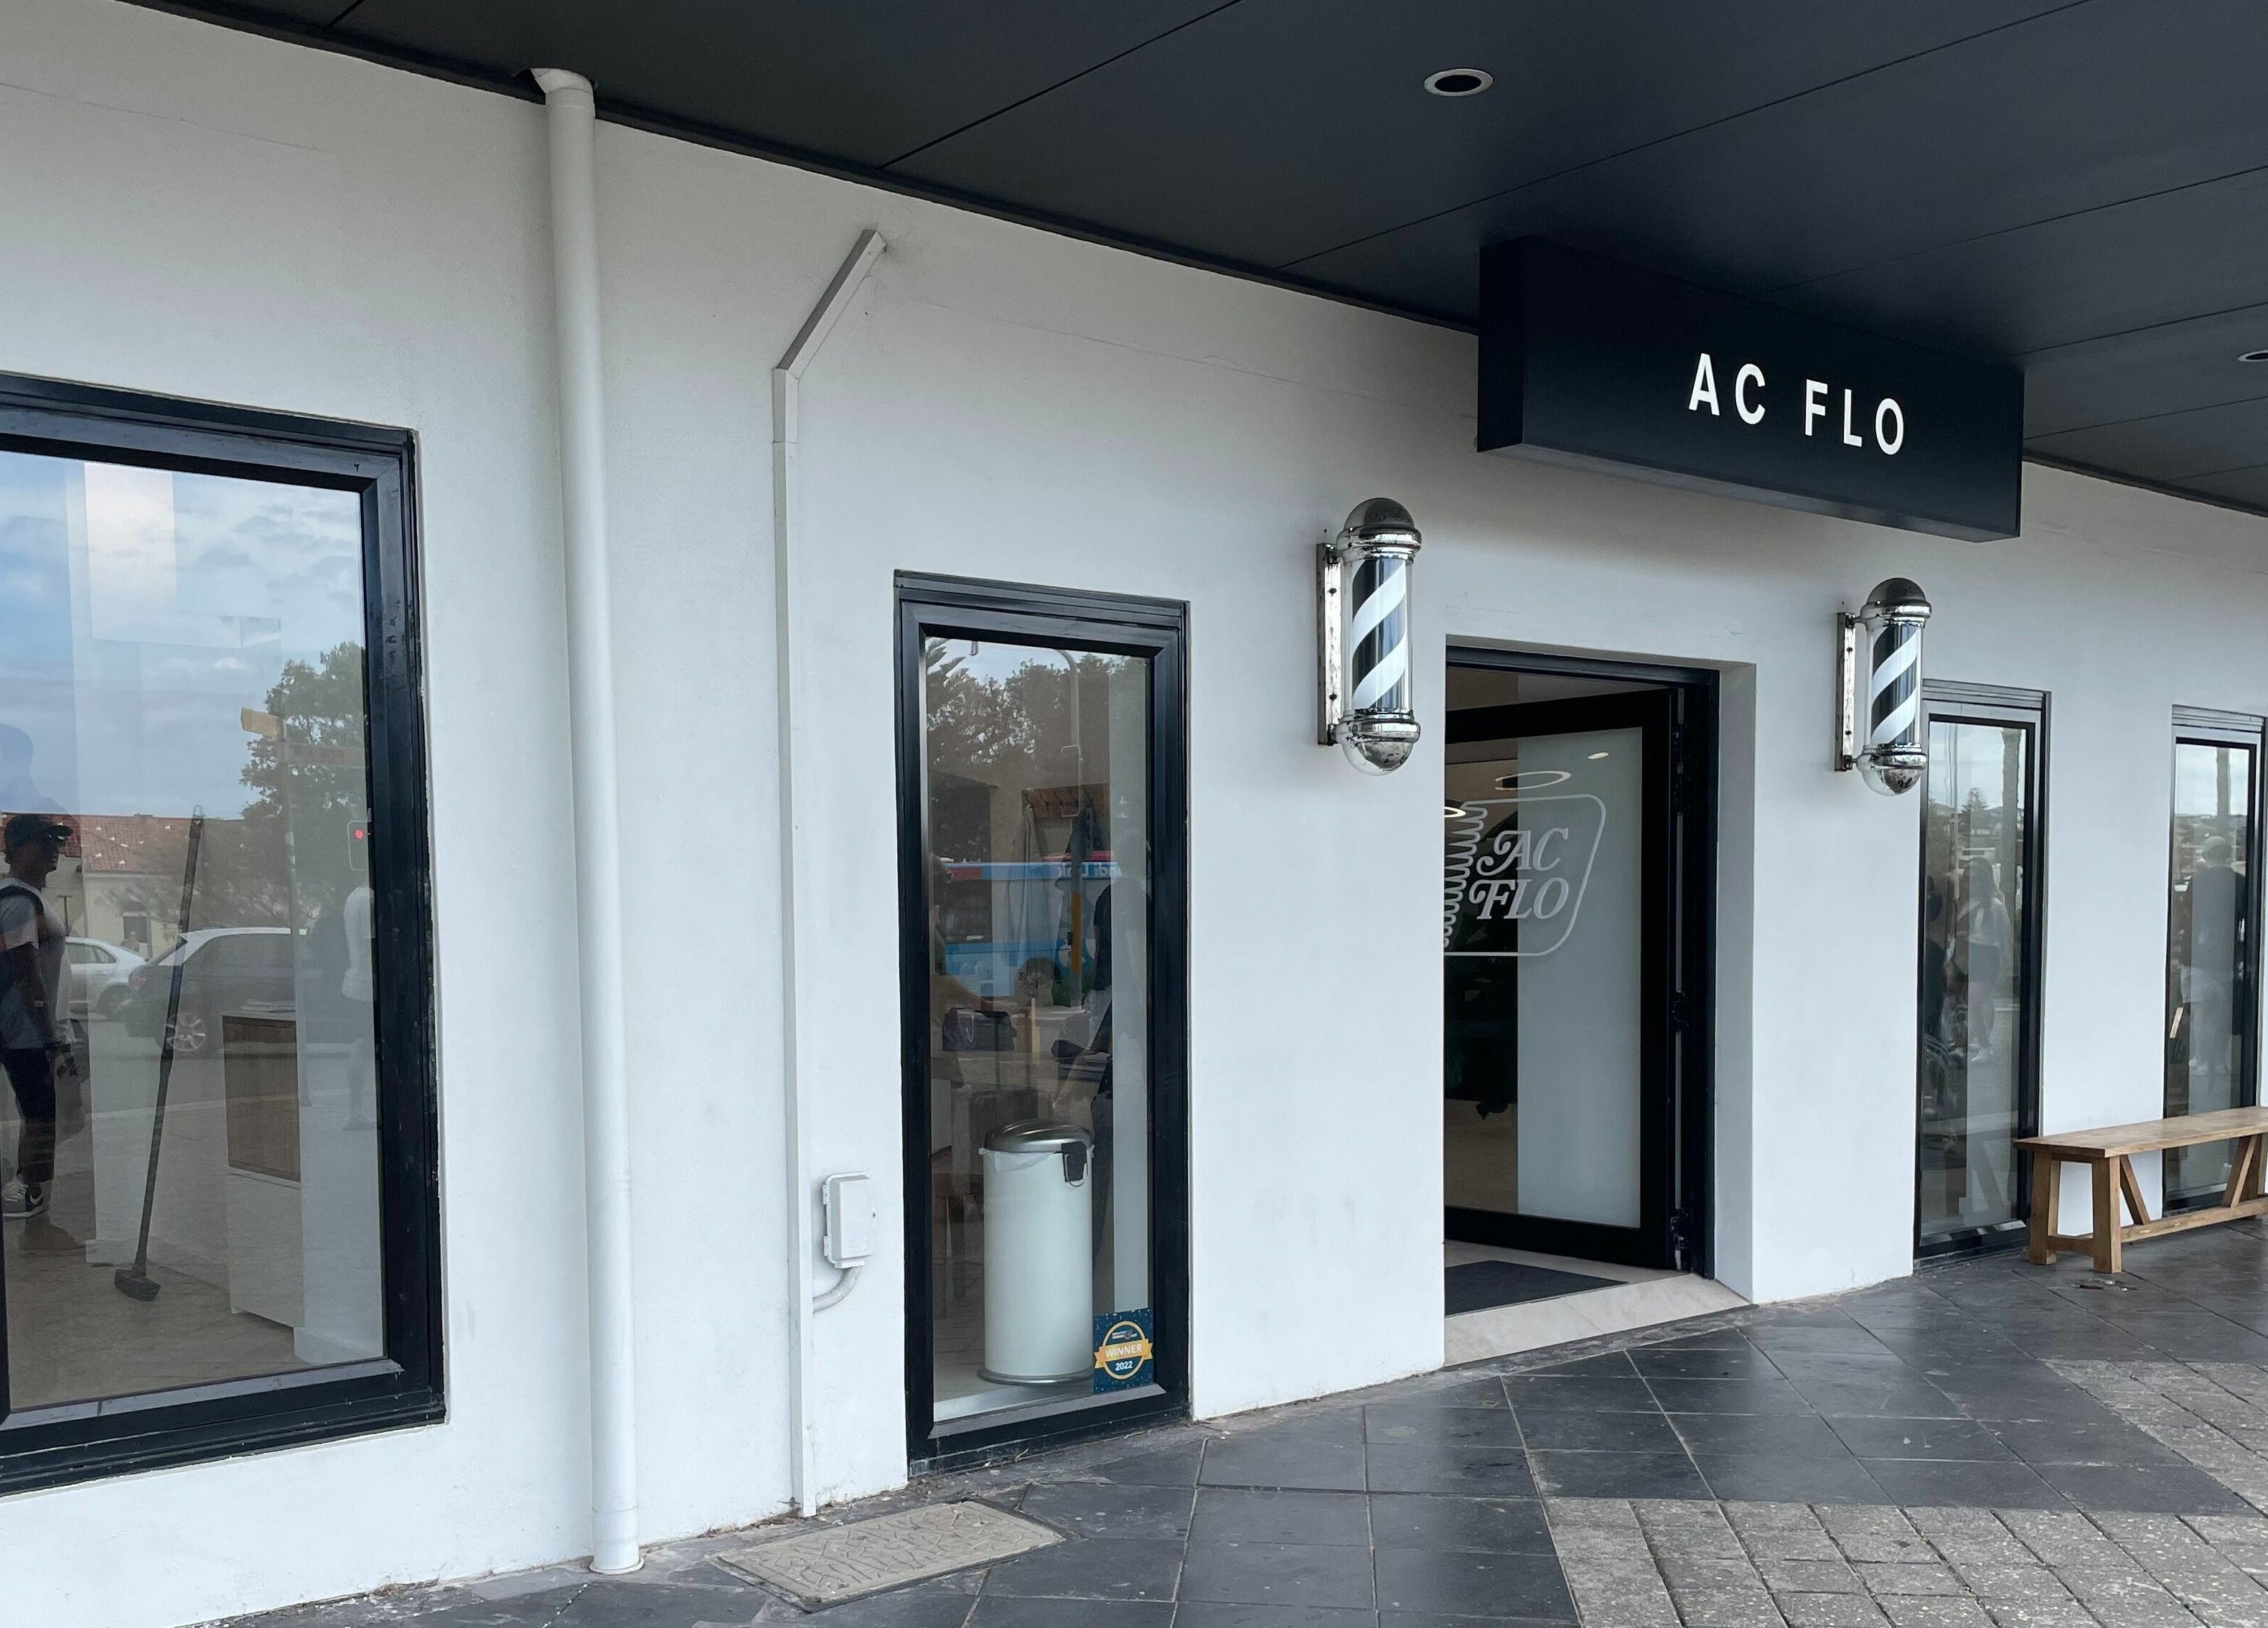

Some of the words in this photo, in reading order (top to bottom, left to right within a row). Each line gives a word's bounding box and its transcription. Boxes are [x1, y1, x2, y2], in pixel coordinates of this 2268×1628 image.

[1688, 352, 1766, 425] AC
[1804, 378, 1904, 455] FLO
[1476, 827, 1569, 876] AC
[1468, 876, 1569, 920] FLO
[1105, 1343, 1143, 1357] WINNER
[1115, 1360, 1133, 1371] 2022
